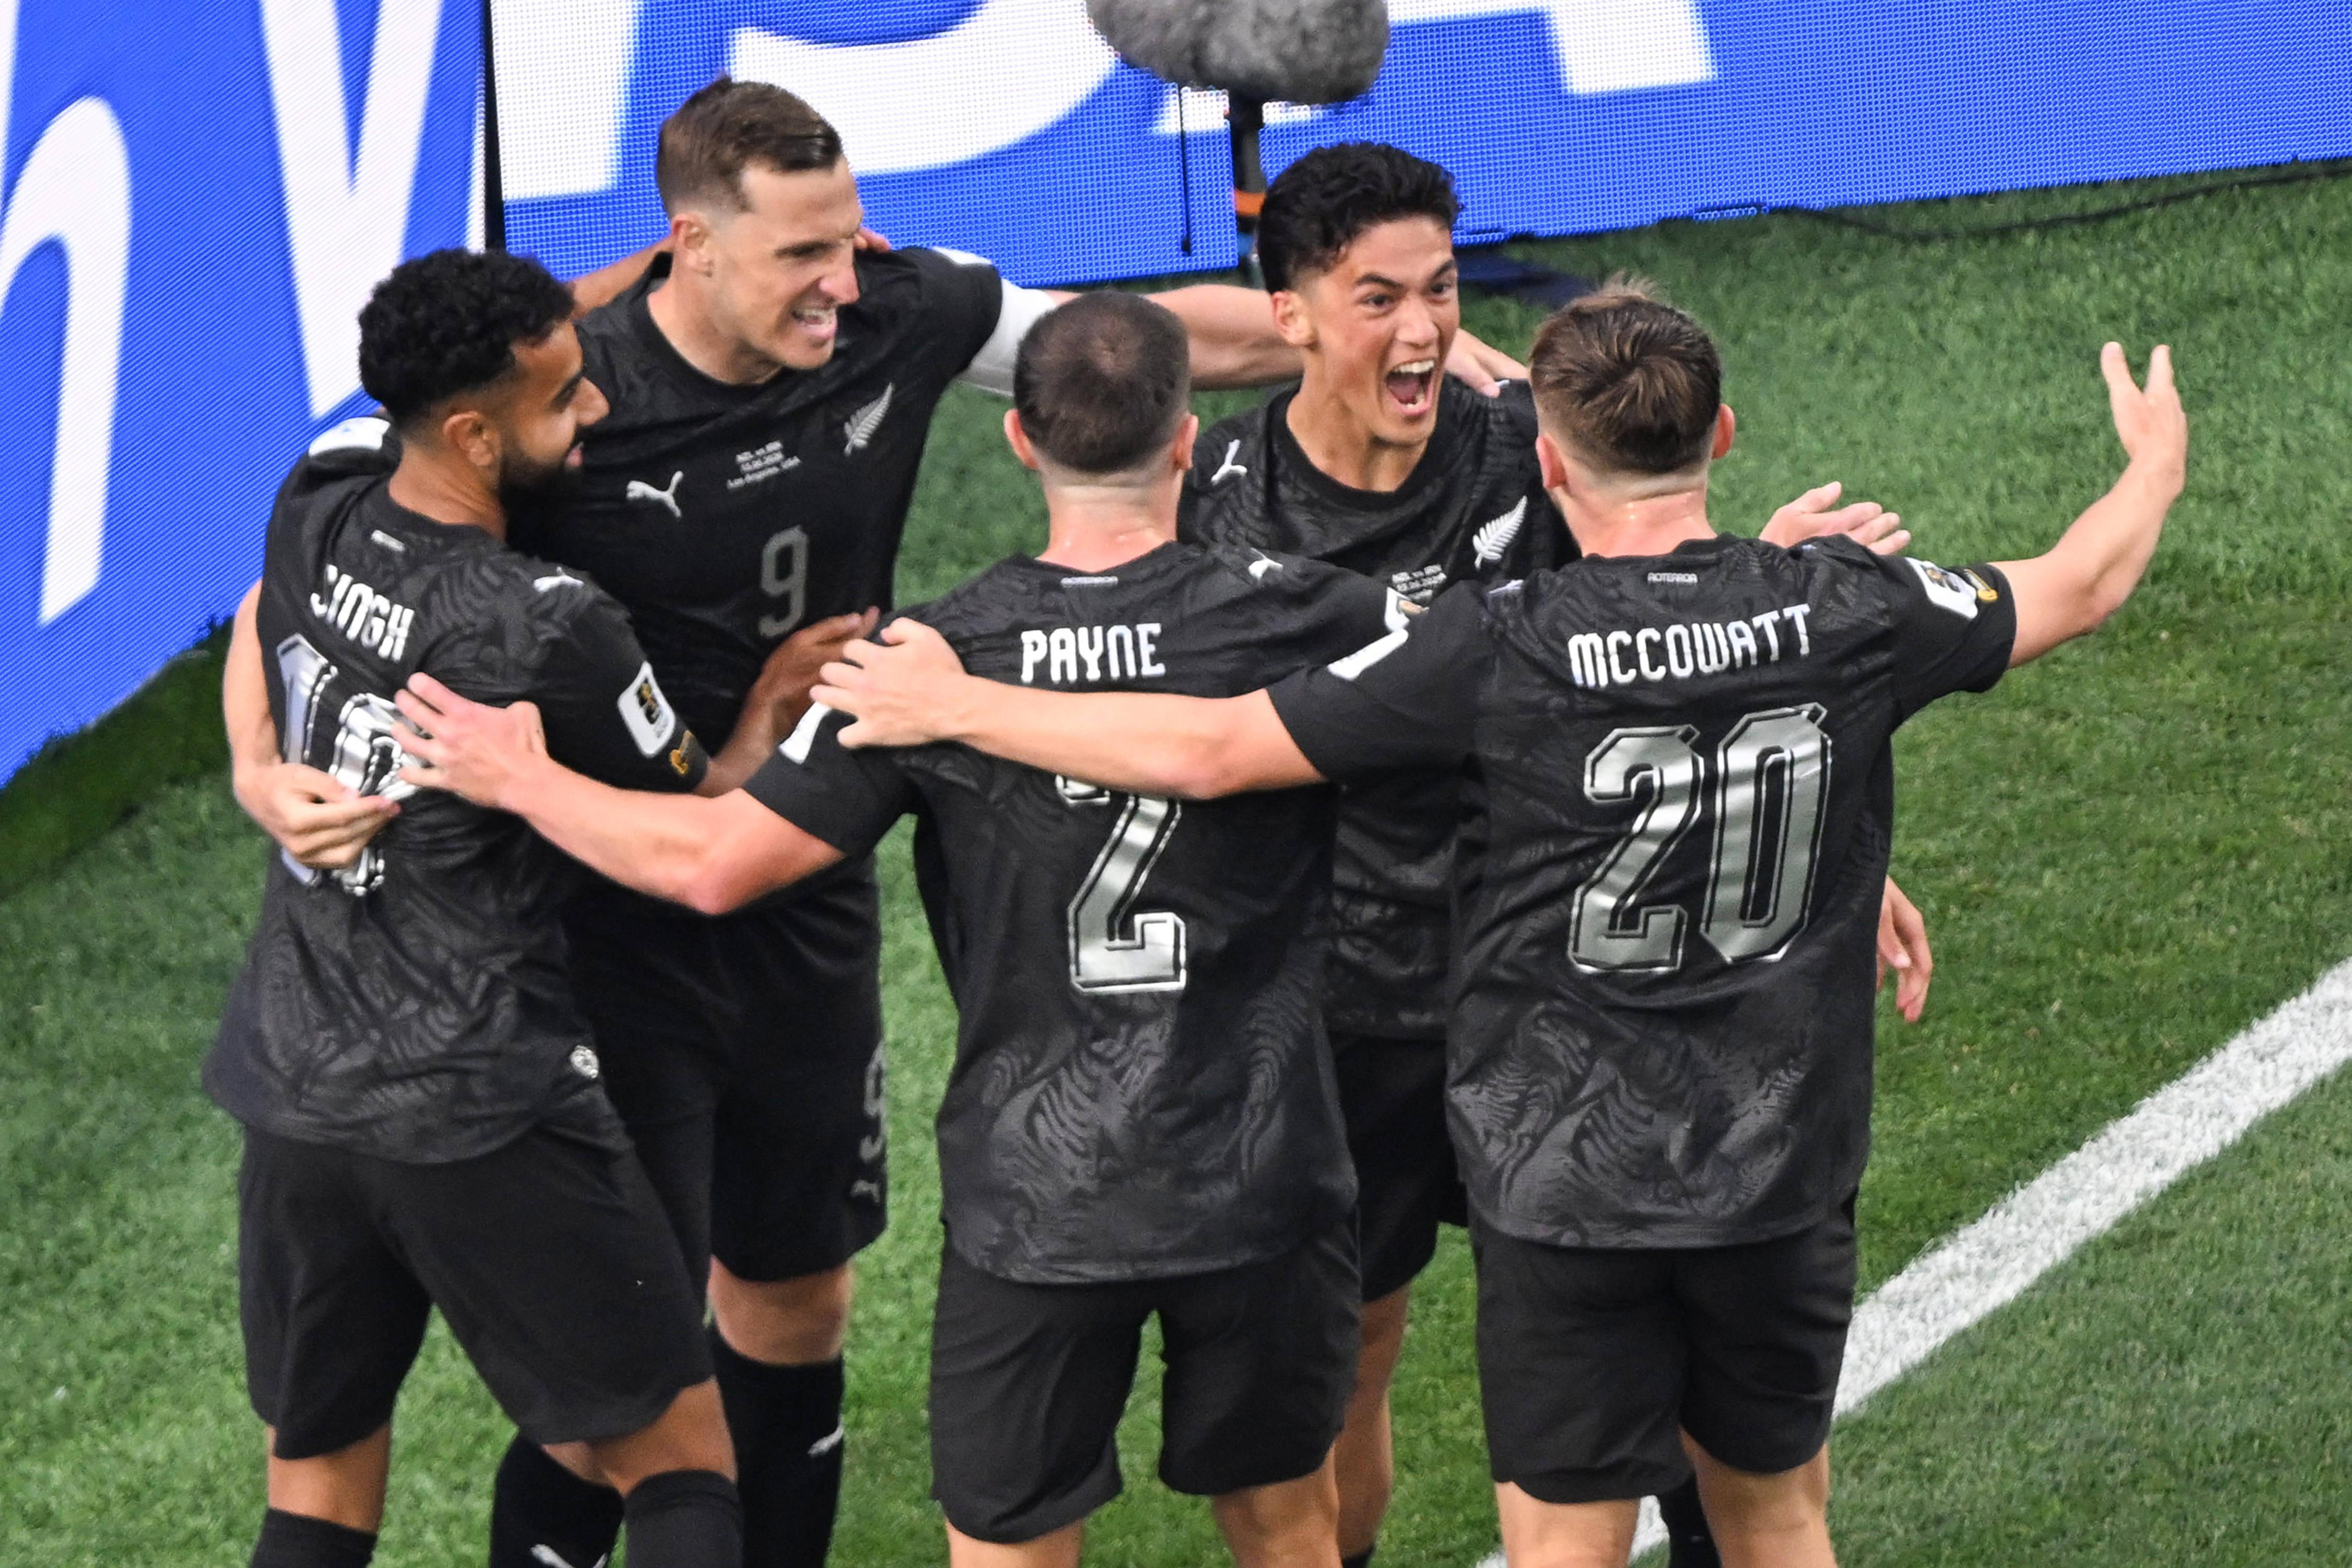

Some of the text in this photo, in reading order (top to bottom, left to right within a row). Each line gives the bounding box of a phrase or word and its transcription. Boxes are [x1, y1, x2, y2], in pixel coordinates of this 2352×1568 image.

[758, 525, 809, 637] 9
[1021, 622, 1166, 683] PAYNE
[1567, 603, 1811, 689] MCCOWATT
[1055, 774, 1187, 995] 2
[1569, 702, 1833, 974] 20
